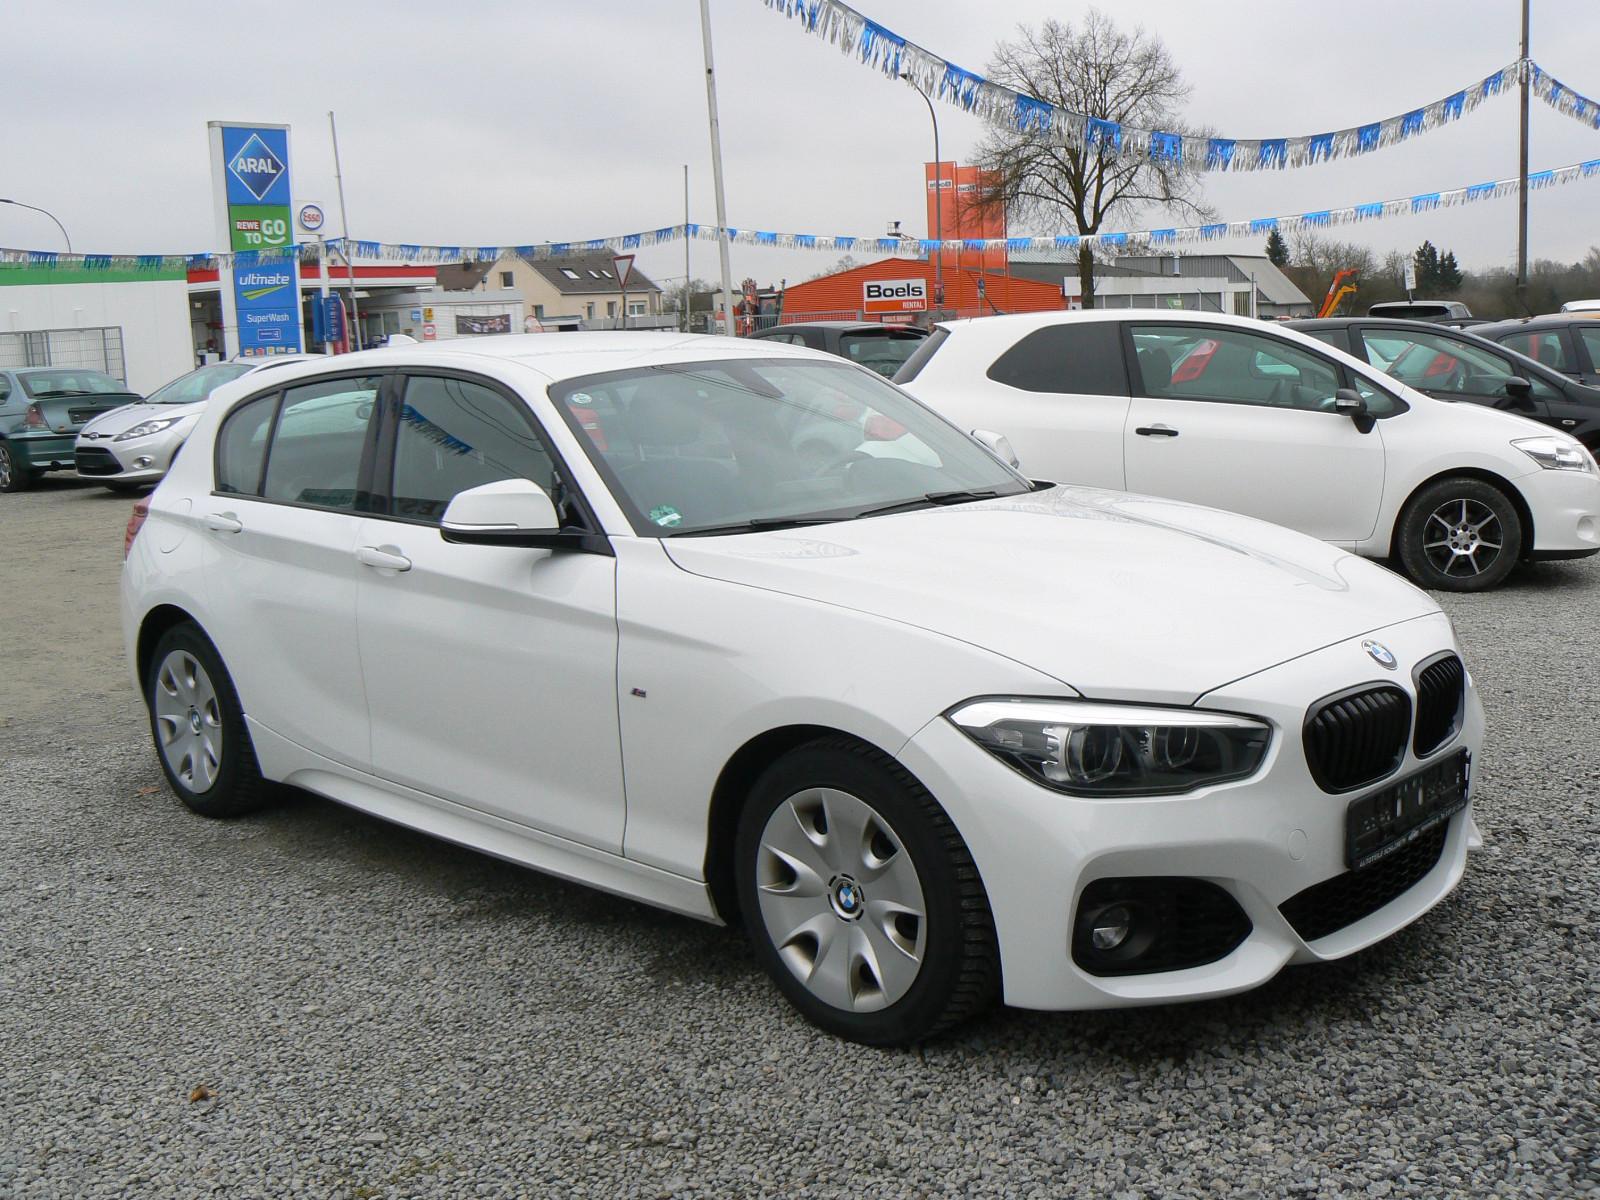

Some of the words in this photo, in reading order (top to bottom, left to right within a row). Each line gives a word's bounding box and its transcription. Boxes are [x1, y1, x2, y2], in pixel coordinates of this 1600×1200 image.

[237, 158, 277, 174] ARAL
[303, 211, 321, 222] Esso
[236, 221, 260, 230] REWE
[244, 233, 261, 244] TO
[261, 219, 286, 235] GO
[239, 273, 290, 286] ultimate
[867, 283, 923, 298] Boels
[902, 301, 924, 310] RENTAL
[246, 313, 290, 325] SuperWash
